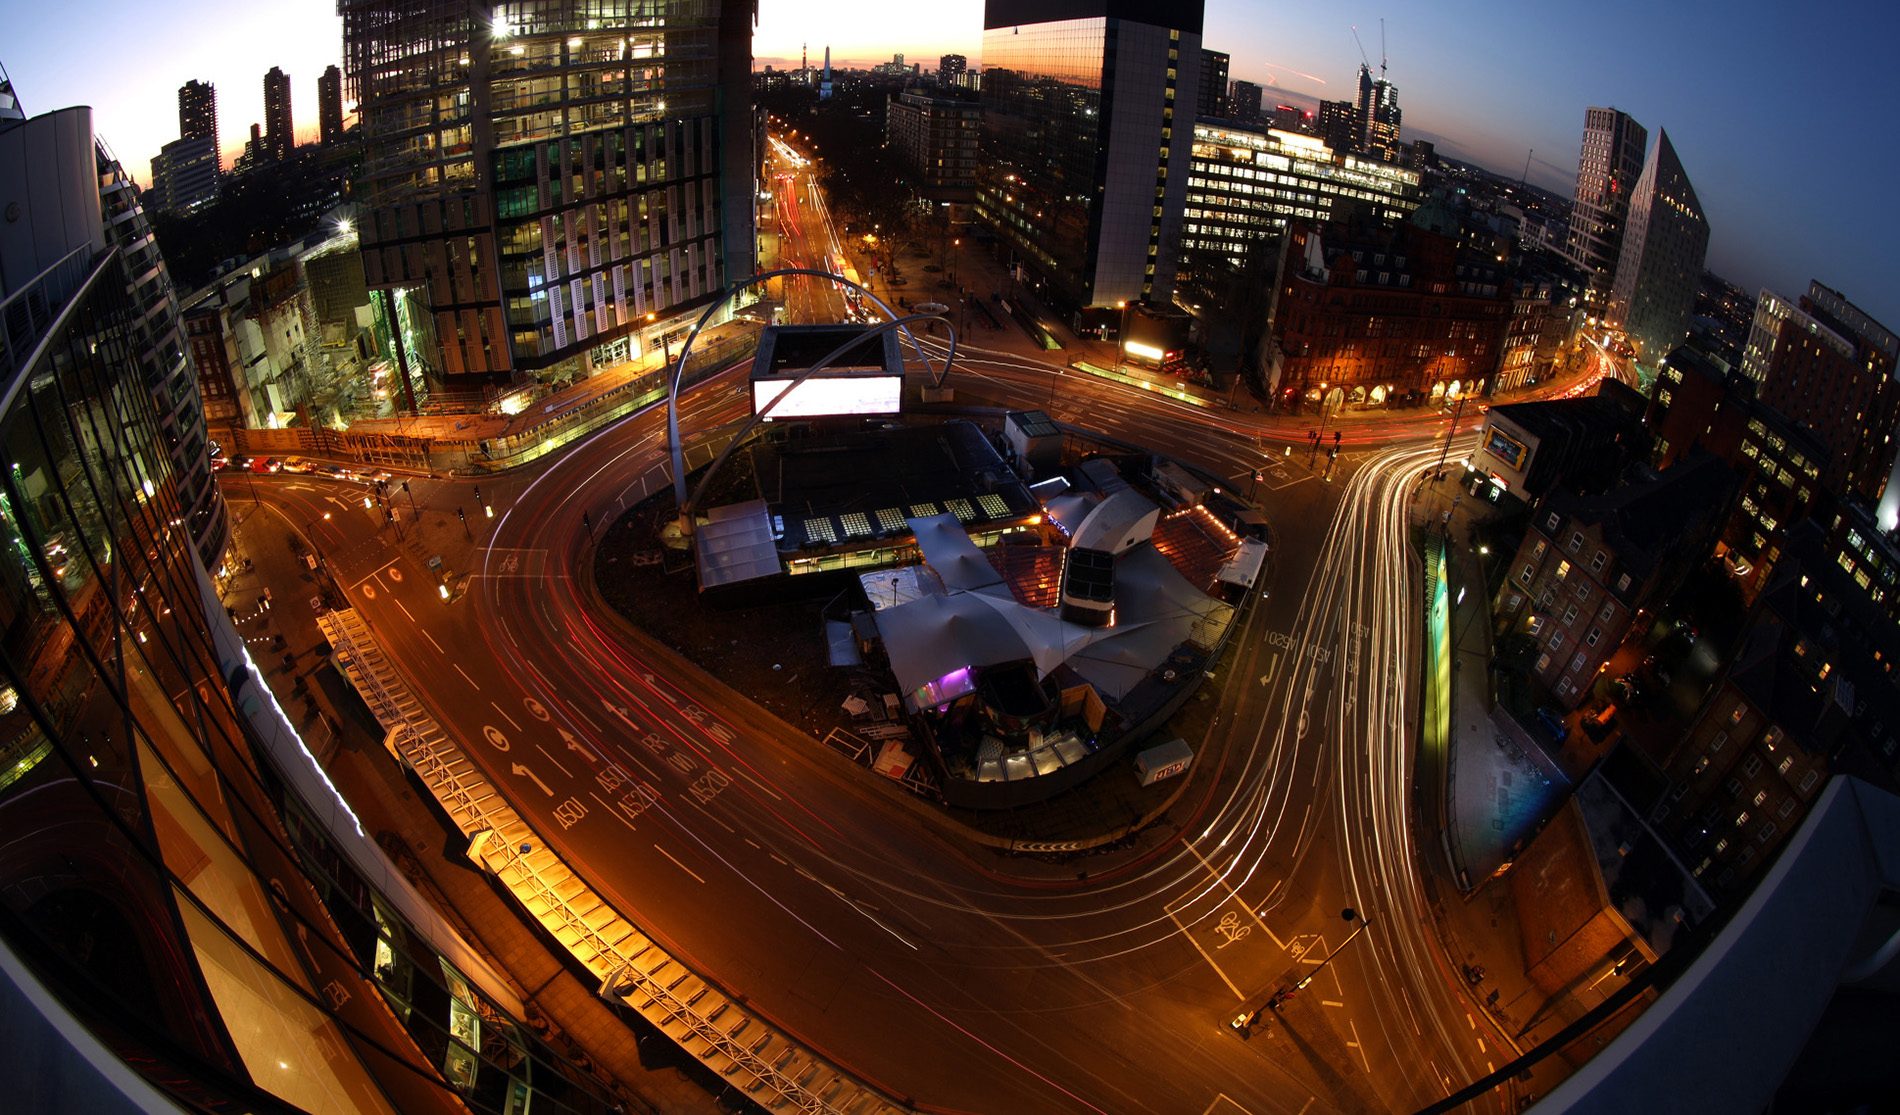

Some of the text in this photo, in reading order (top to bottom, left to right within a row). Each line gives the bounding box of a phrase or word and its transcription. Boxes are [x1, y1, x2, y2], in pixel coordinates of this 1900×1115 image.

[1264, 629, 1297, 651] A5201
[1351, 621, 1369, 638] A50
[1306, 642, 1331, 664] A501
[595, 762, 632, 794] A501
[688, 766, 734, 805] A5201
[552, 796, 589, 830] A501
[617, 781, 662, 819] A5201
